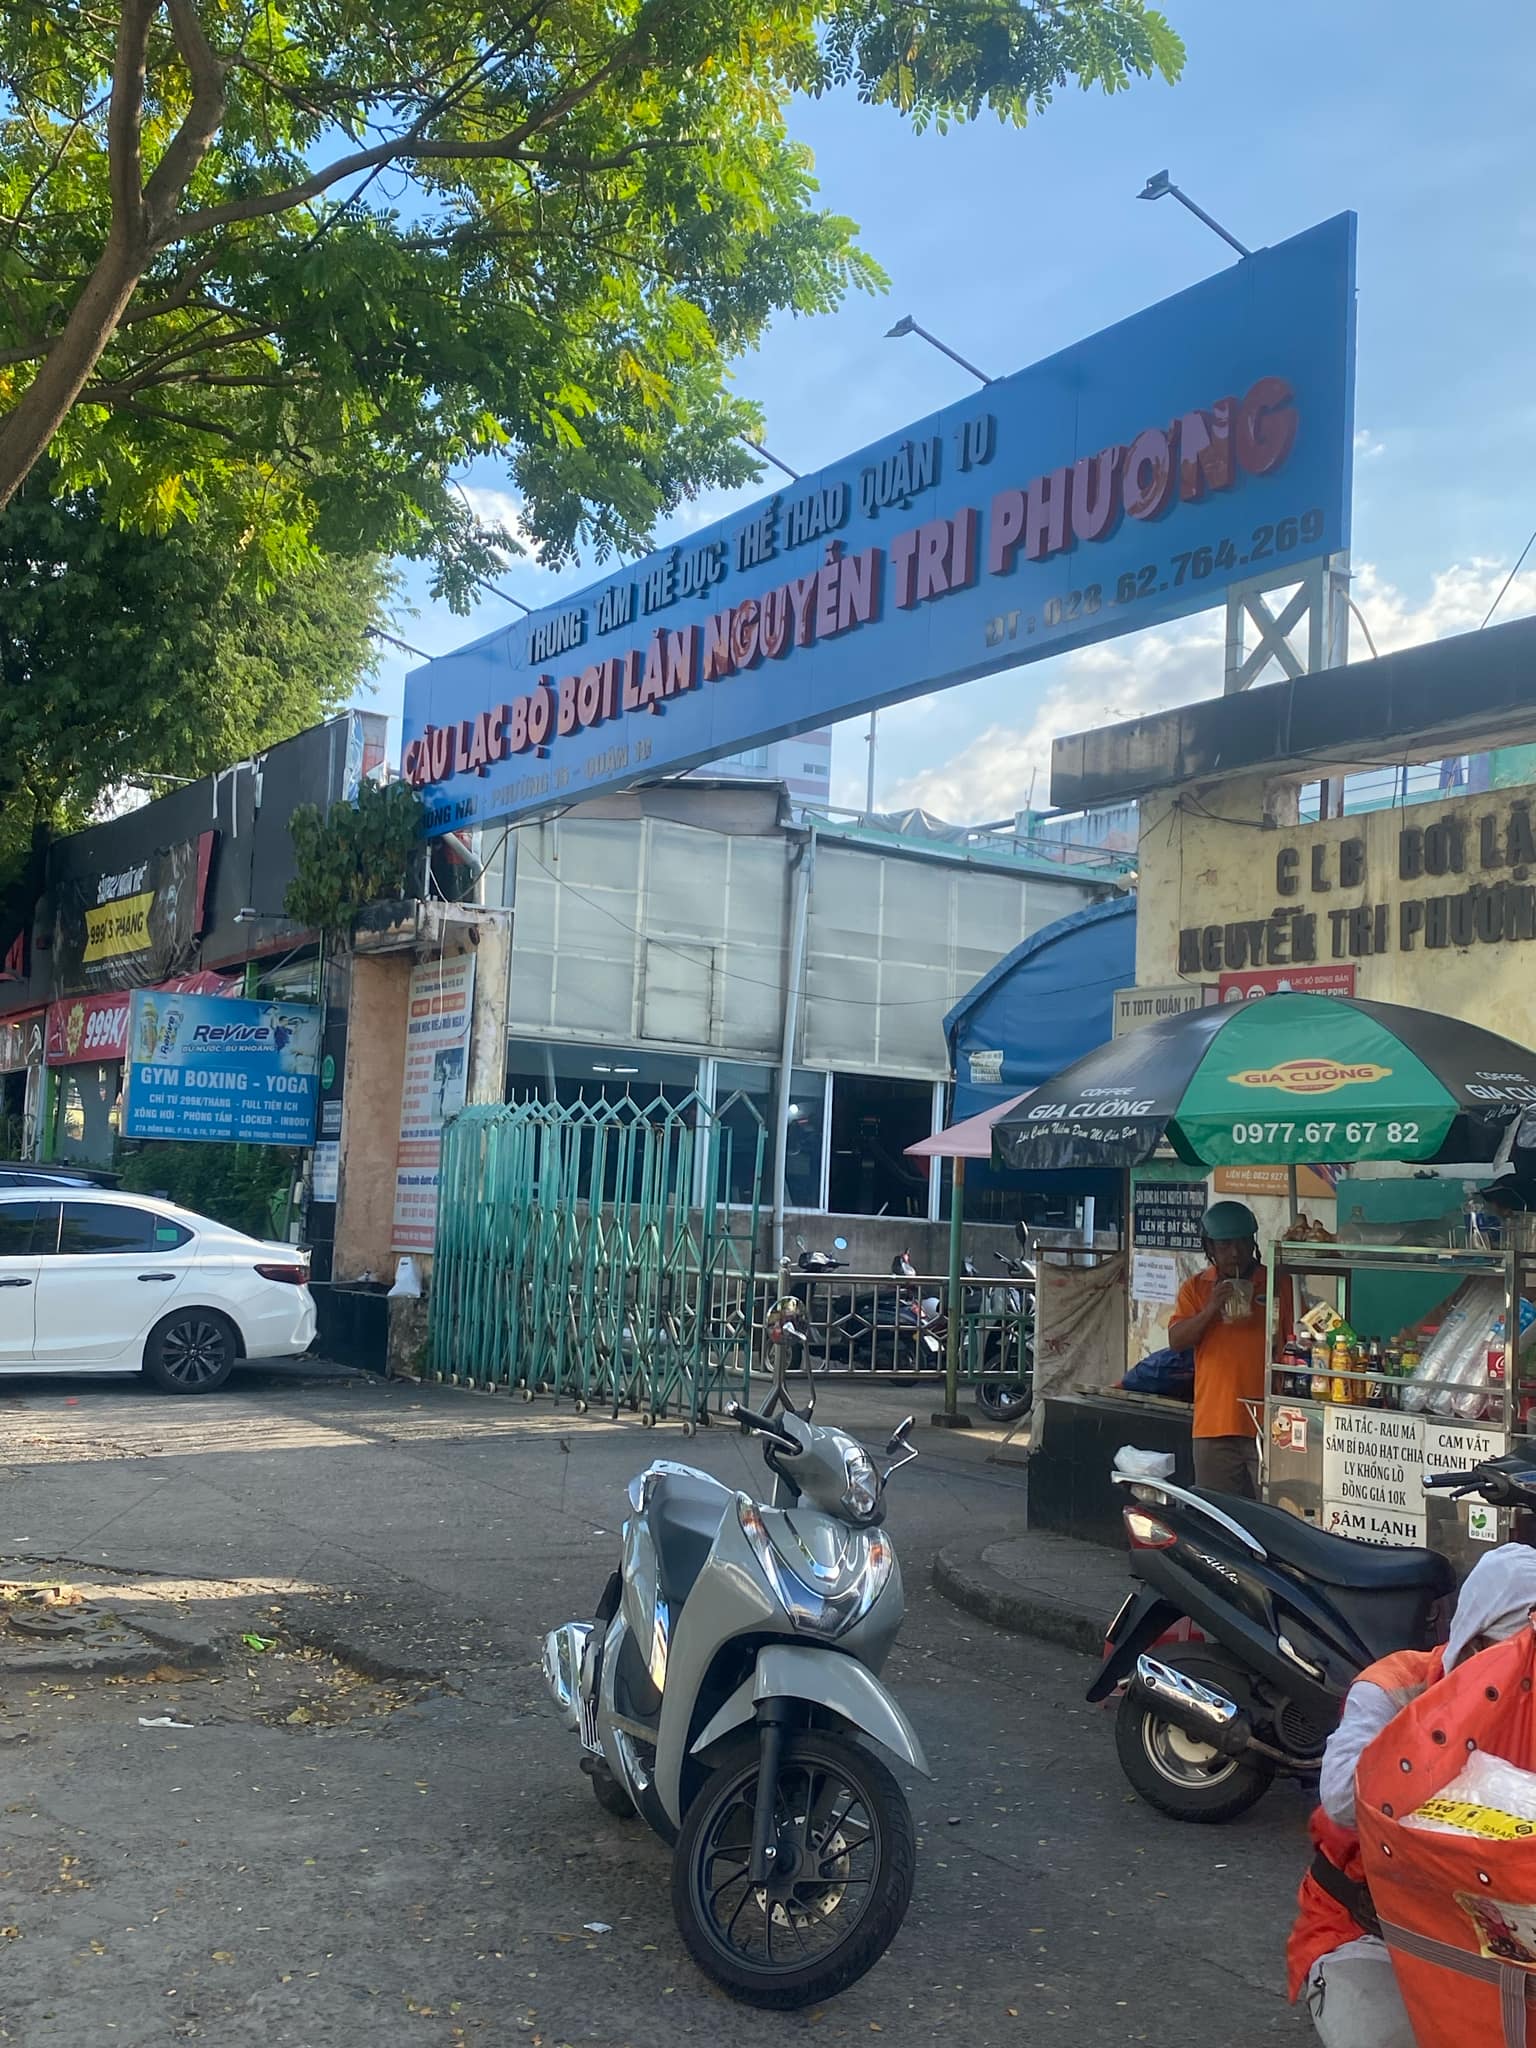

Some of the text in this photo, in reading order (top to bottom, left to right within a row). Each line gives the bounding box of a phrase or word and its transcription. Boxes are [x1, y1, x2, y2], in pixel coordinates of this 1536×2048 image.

[527, 607, 588, 666] TRUNG
[596, 583, 638, 636] TÂM
[679, 543, 729, 600] DỤC
[781, 481, 851, 550] THAO
[858, 437, 941, 519] QUẬN
[954, 413, 996, 472] 10
[402, 724, 457, 786] CÂU
[456, 703, 511, 777] LẠC
[509, 674, 557, 759] BỘ
[558, 657, 623, 736] BƠI
[623, 624, 704, 715] LẶN
[891, 508, 981, 610] TRI
[988, 375, 1298, 575] PHƯƠNG
[1328, 903, 1390, 957] TRI
[1399, 880, 1536, 951] PHƯƠN
[1120, 1001, 1131, 1017] TT
[1132, 999, 1153, 1016] TDTT
[140, 1067, 179, 1086] GYM
[184, 1070, 248, 1091] BOXING
[265, 1075, 309, 1094] YOGA
[1245, 1073, 1285, 1084] GIA
[1475, 1071, 1530, 1082] COFFEE
[1080, 1087, 1137, 1097] COFFEE
[1465, 1084, 1513, 1100] GIA
[241, 1099, 262, 1110] FULL
[1028, 1103, 1067, 1119] GIA
[240, 1115, 272, 1126] LOCKER
[1232, 1121, 1419, 1144] 0977.67 67 82
[1335, 1413, 1353, 1432] TRÀ
[1355, 1414, 1373, 1434] TẮC
[1380, 1422, 1399, 1438] RAU
[1401, 1422, 1416, 1440] MÁ
[1326, 1434, 1424, 1463] SÂM BÍ ĐAO HẠT CHIA
[1438, 1433, 1490, 1452] CAM VẮT
[1427, 1452, 1467, 1470] CHANH
[1344, 1461, 1355, 1476] LY
[1392, 1463, 1404, 1483] LỒ
[1342, 1479, 1406, 1505] ĐỒNG GIÁ 10K
[1331, 1510, 1417, 1538] SÂM LẠNH
